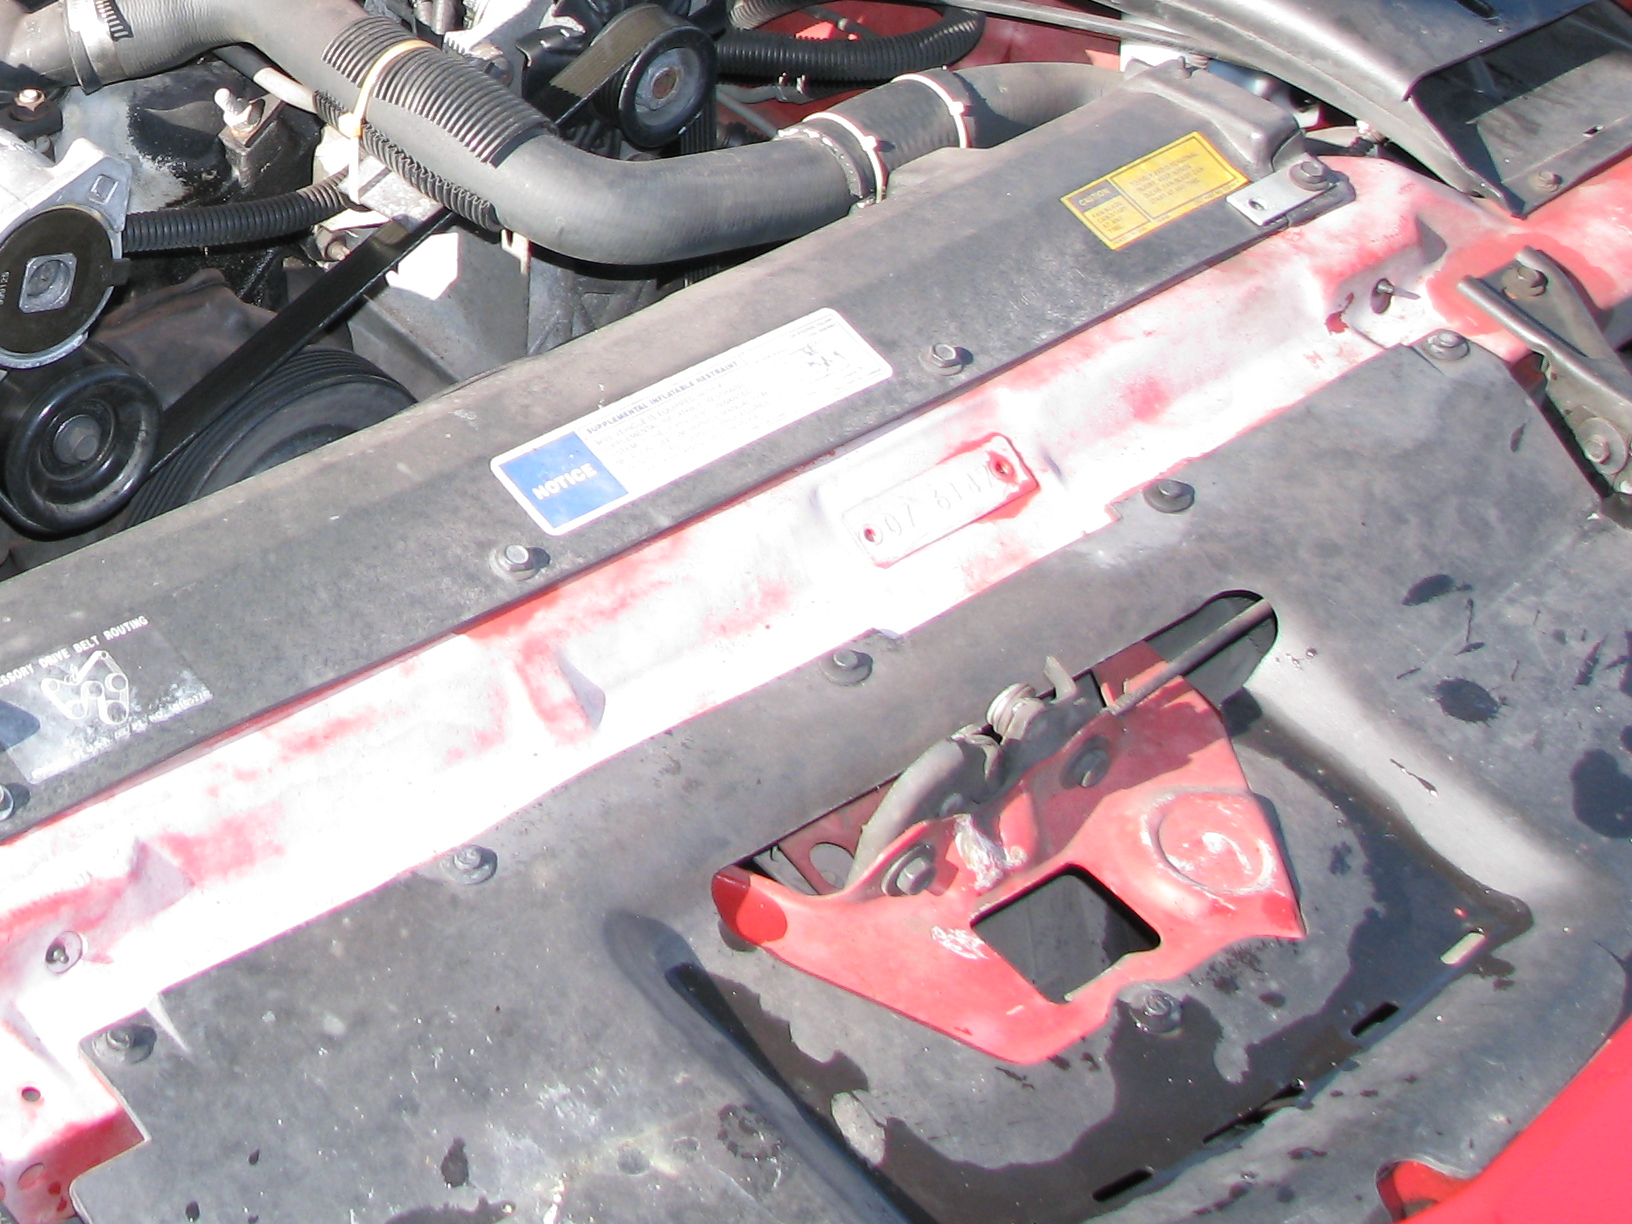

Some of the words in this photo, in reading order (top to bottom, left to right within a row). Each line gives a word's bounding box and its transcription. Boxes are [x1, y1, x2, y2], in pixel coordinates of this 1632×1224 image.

[1078, 187, 1112, 206] CAUTION
[585, 402, 649, 434] SUPPLEMENTAL
[647, 380, 696, 405] INFLATABLE
[694, 360, 740, 383] RESTRAINT
[532, 462, 598, 500] NOTICE
[38, 648, 70, 669] DRIVE
[73, 635, 100, 654] BELT
[103, 615, 149, 641] ROUTING
